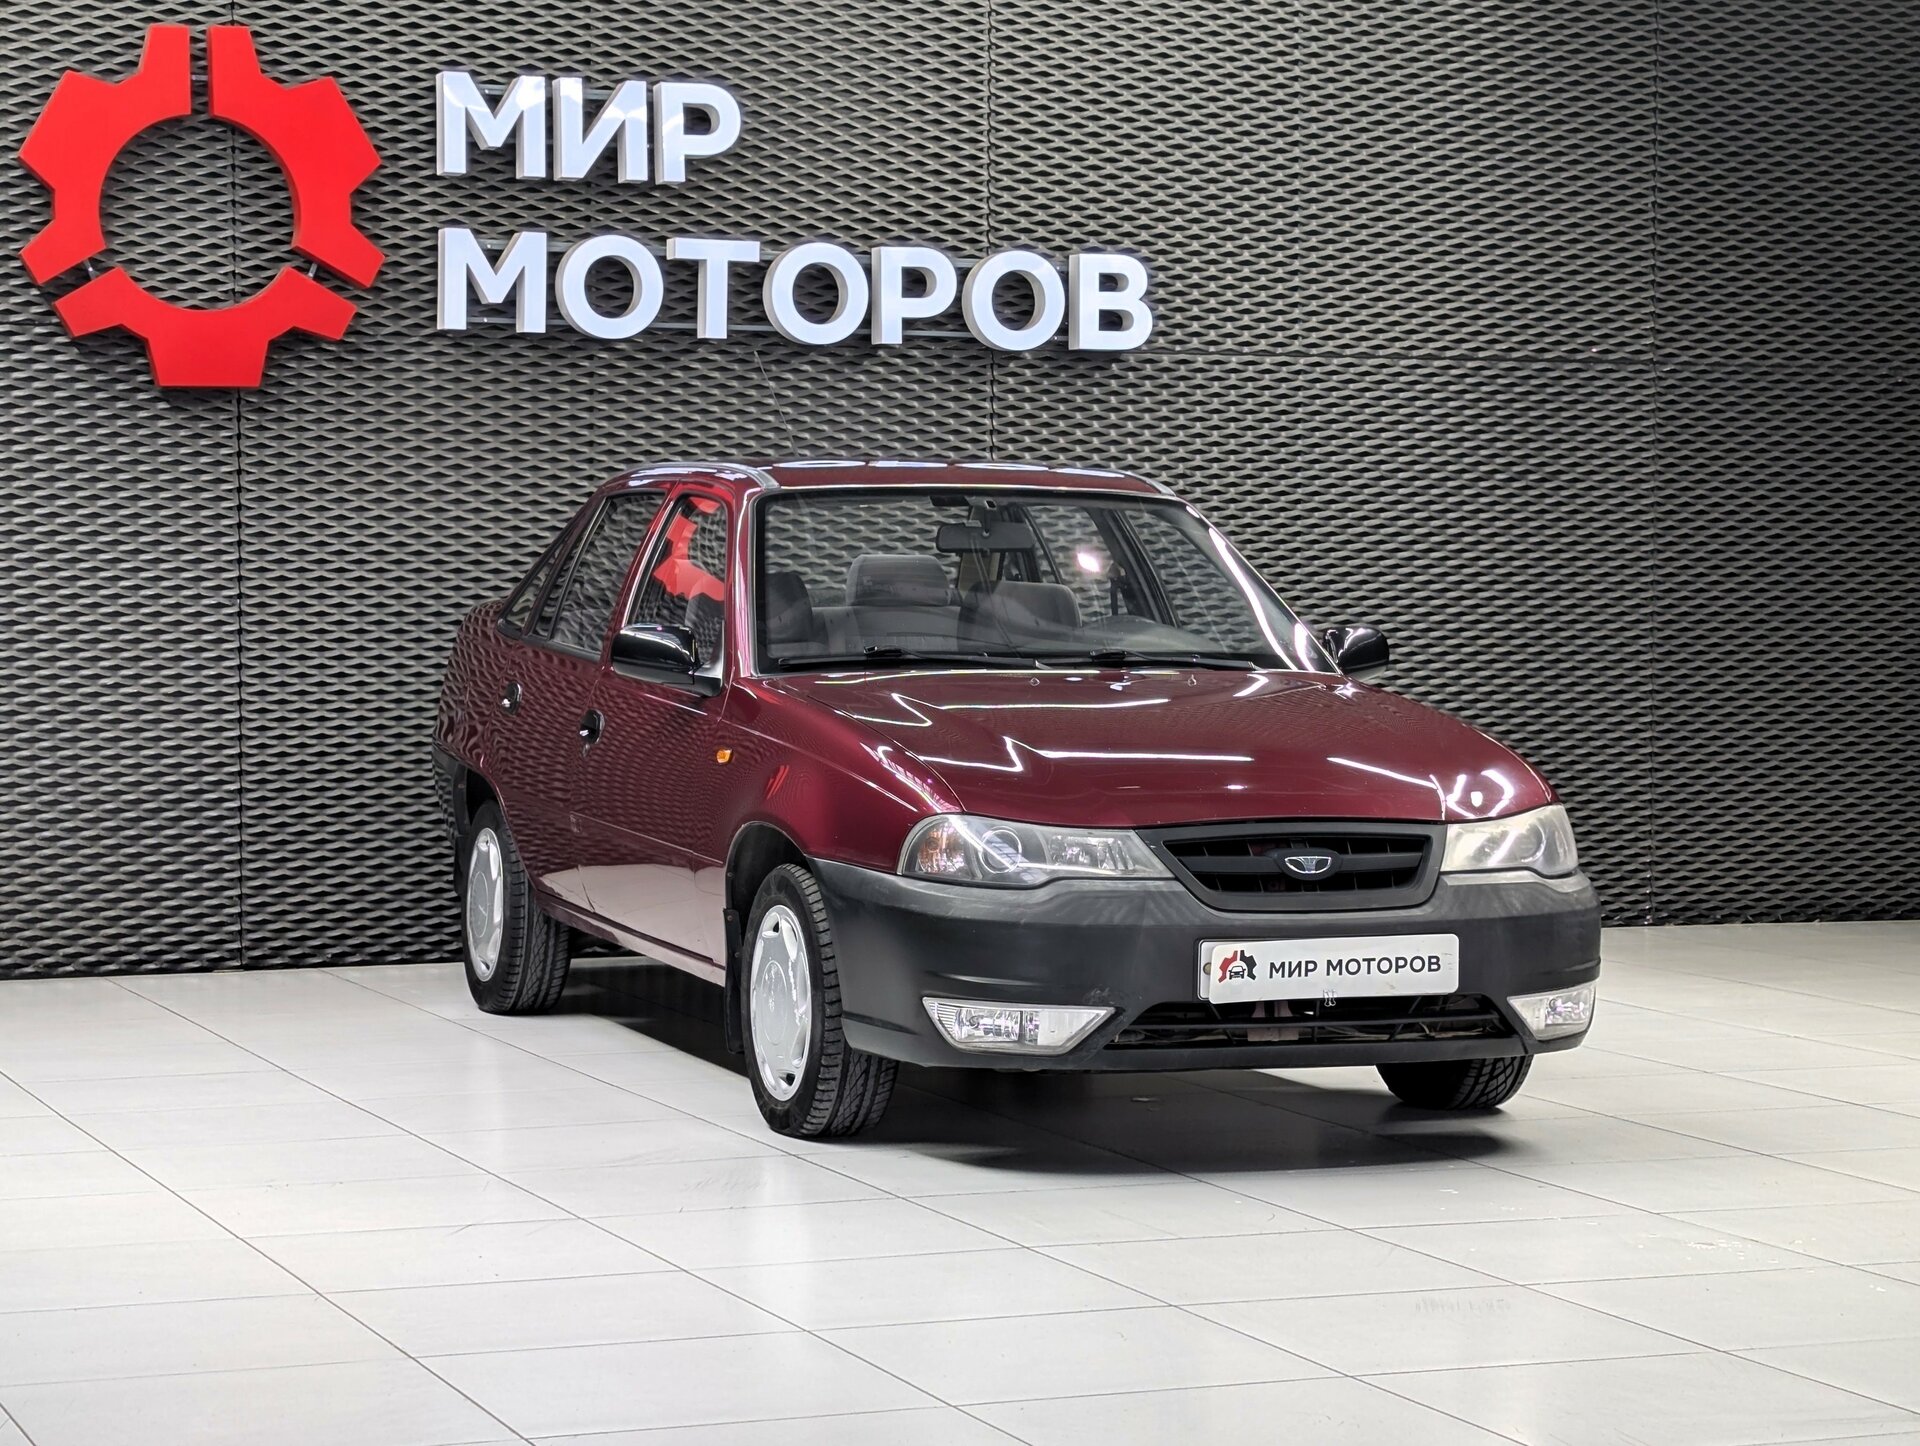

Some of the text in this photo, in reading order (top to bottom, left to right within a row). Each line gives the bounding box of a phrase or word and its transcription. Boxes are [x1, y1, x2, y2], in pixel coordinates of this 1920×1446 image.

[436, 70, 742, 185] МИР
[436, 227, 1154, 351] МОТОРОВ
[1269, 955, 1441, 979] МИР МОТОРОВ
